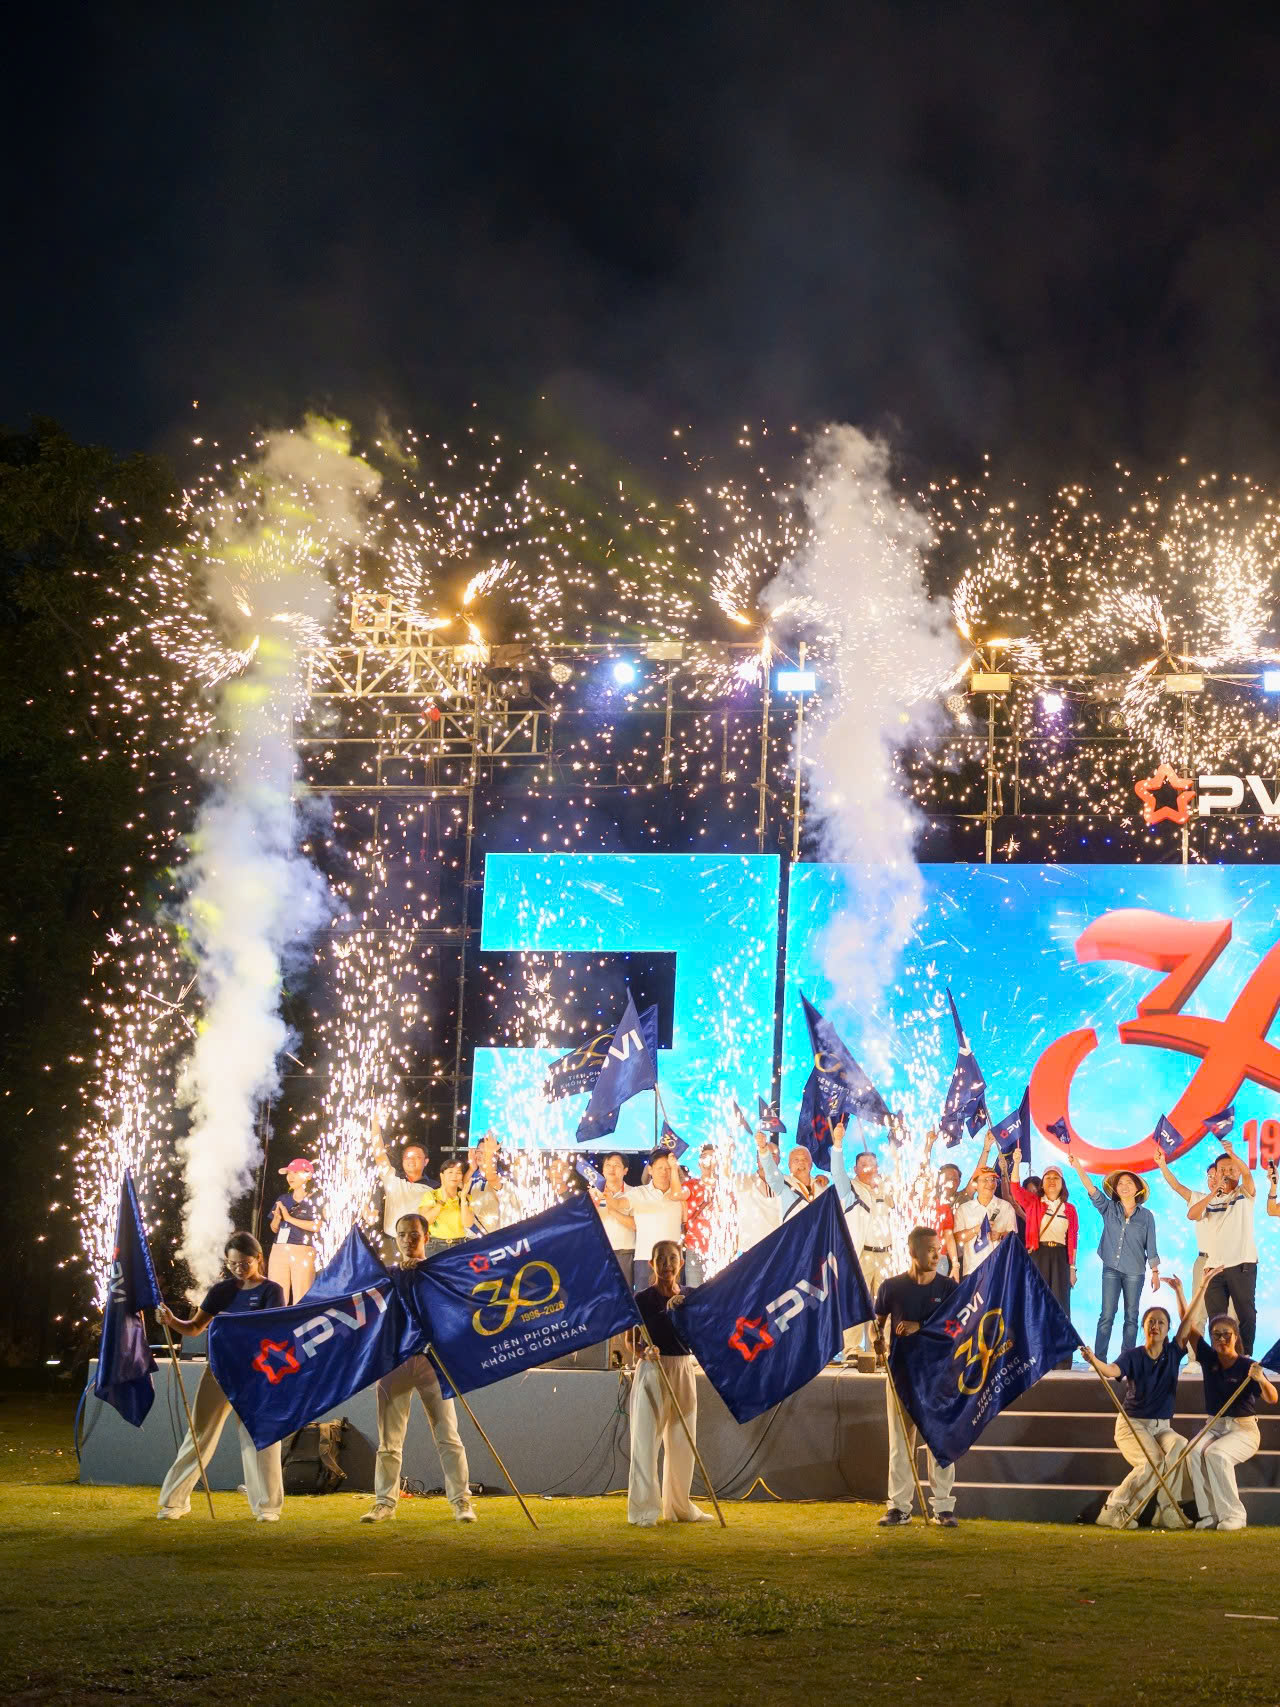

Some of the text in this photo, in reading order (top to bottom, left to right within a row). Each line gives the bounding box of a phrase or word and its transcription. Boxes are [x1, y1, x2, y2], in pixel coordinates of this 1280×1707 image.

[602, 1029, 644, 1069] VI
[1160, 1130, 1176, 1146] PVI
[488, 1238, 532, 1265] PVI
[110, 1261, 128, 1303] PVI
[471, 1260, 561, 1337] 30
[292, 1287, 388, 1359] PVI
[956, 1291, 985, 1326] PVI
[481, 1347, 526, 1369] KHÔNG
[560, 1323, 588, 1341] HẠN
[490, 1320, 570, 1354] TIÊN PHONG
